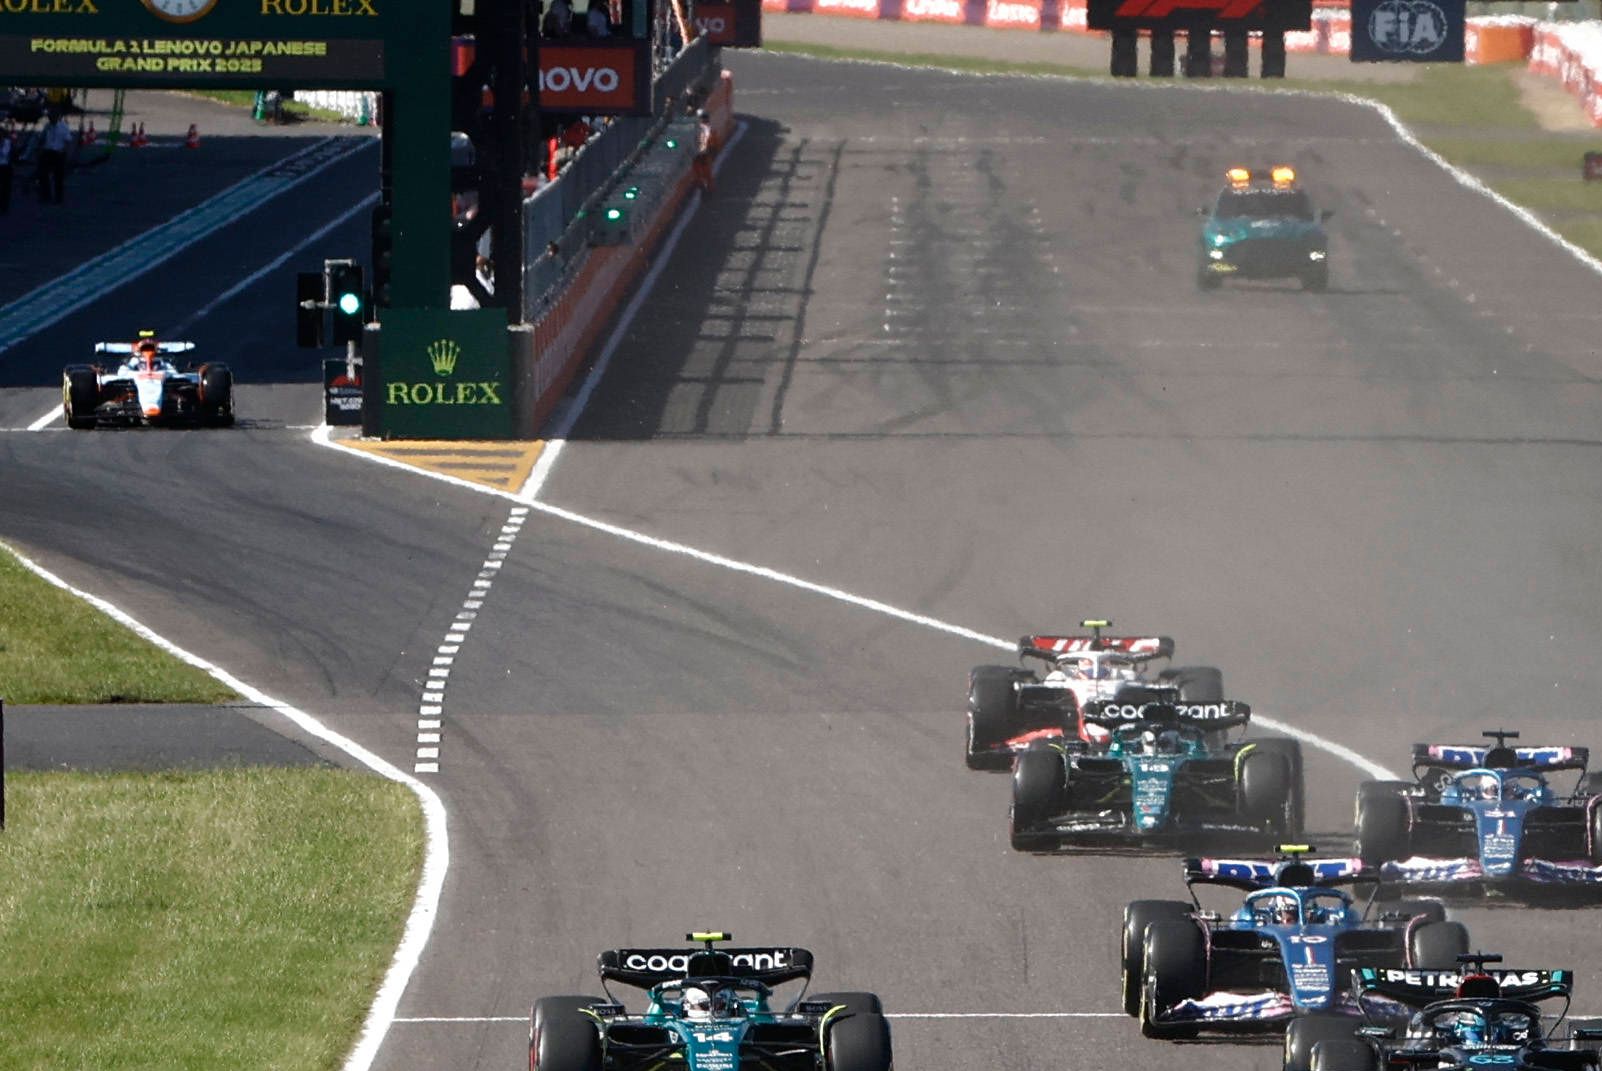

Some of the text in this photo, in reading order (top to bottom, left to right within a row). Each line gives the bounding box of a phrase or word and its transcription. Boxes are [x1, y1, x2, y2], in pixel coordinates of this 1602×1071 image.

[31, 38, 328, 56] FORMULA 1 LENOVO JAPANESE
[96, 57, 165, 71] GRAND
[167, 57, 211, 72] PRIX
[386, 382, 502, 404] ROLEX
[693, 1032, 734, 1042] 14
